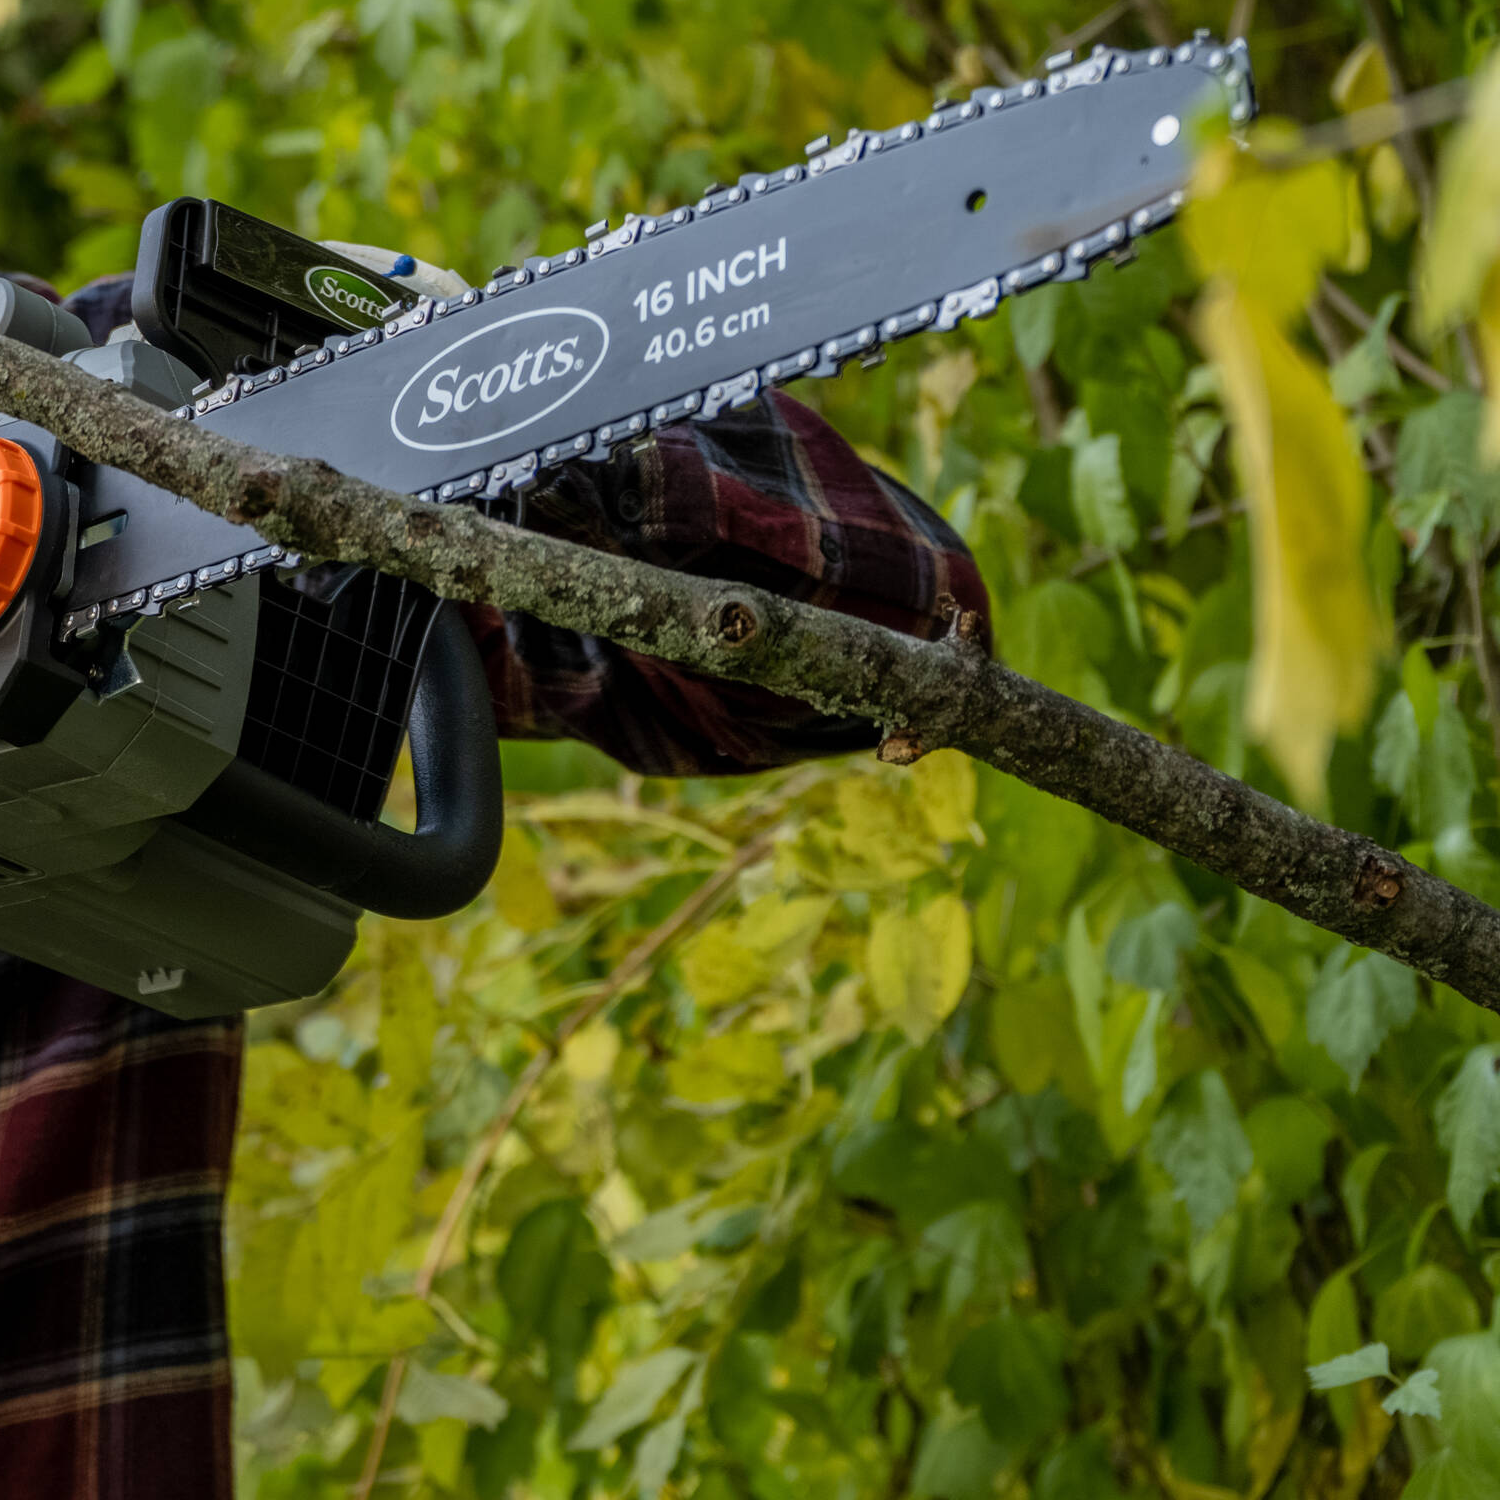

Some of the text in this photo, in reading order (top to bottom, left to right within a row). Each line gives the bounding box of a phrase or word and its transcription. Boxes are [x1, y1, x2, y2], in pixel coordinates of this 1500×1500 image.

[320, 276, 384, 321] Scotts
[633, 237, 787, 323] 16 INCH
[644, 302, 771, 365] 40.6 cm
